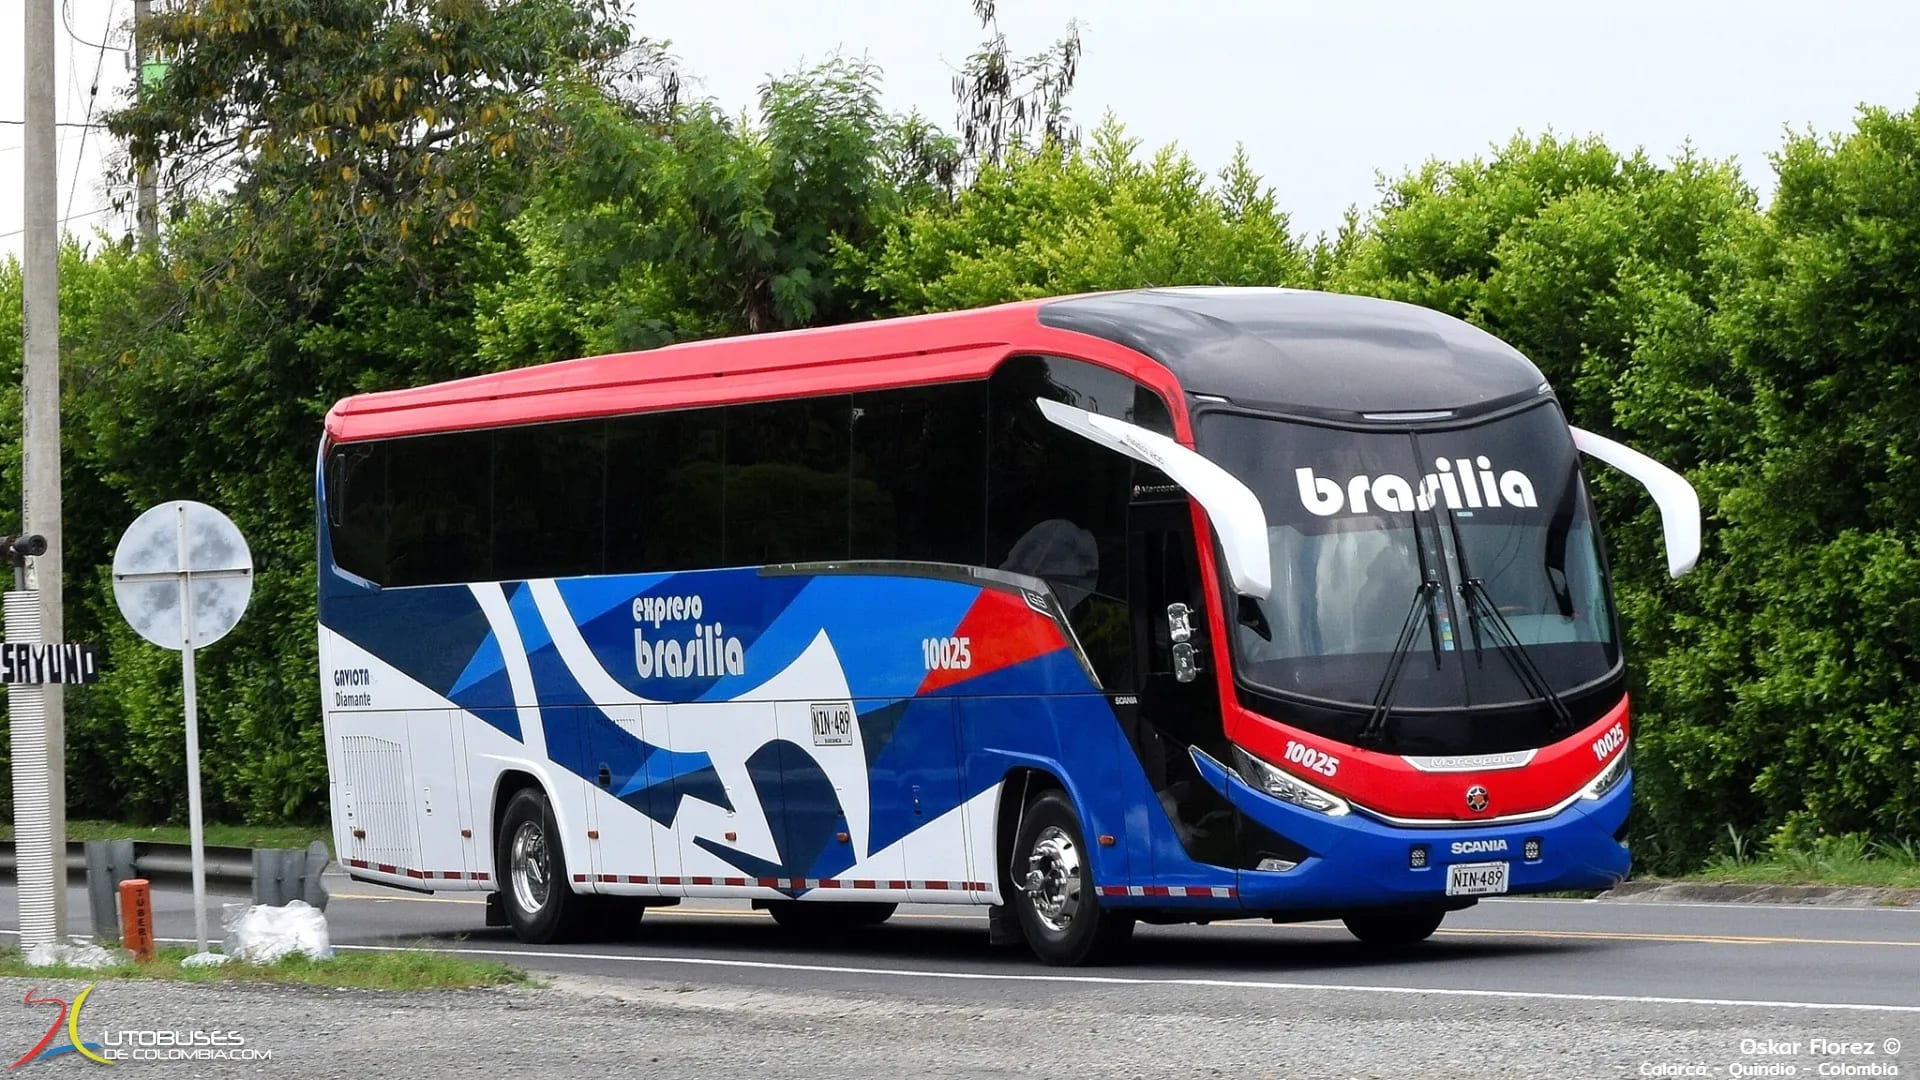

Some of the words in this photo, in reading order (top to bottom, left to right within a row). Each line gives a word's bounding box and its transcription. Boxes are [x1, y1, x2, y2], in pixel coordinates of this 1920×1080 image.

[1295, 455, 1539, 516] brasilia
[632, 595, 703, 629] expreso
[634, 622, 745, 679] brasilia
[922, 636, 972, 670] 10025
[334, 668, 370, 686] GAVIOTA
[335, 690, 371, 707] Diamante
[1114, 696, 1138, 705] SCANIA
[1284, 740, 1340, 777] 10025
[1592, 721, 1624, 762] 10025
[1431, 754, 1514, 767] Marcopolo
[1451, 840, 1508, 854] SCANIA
